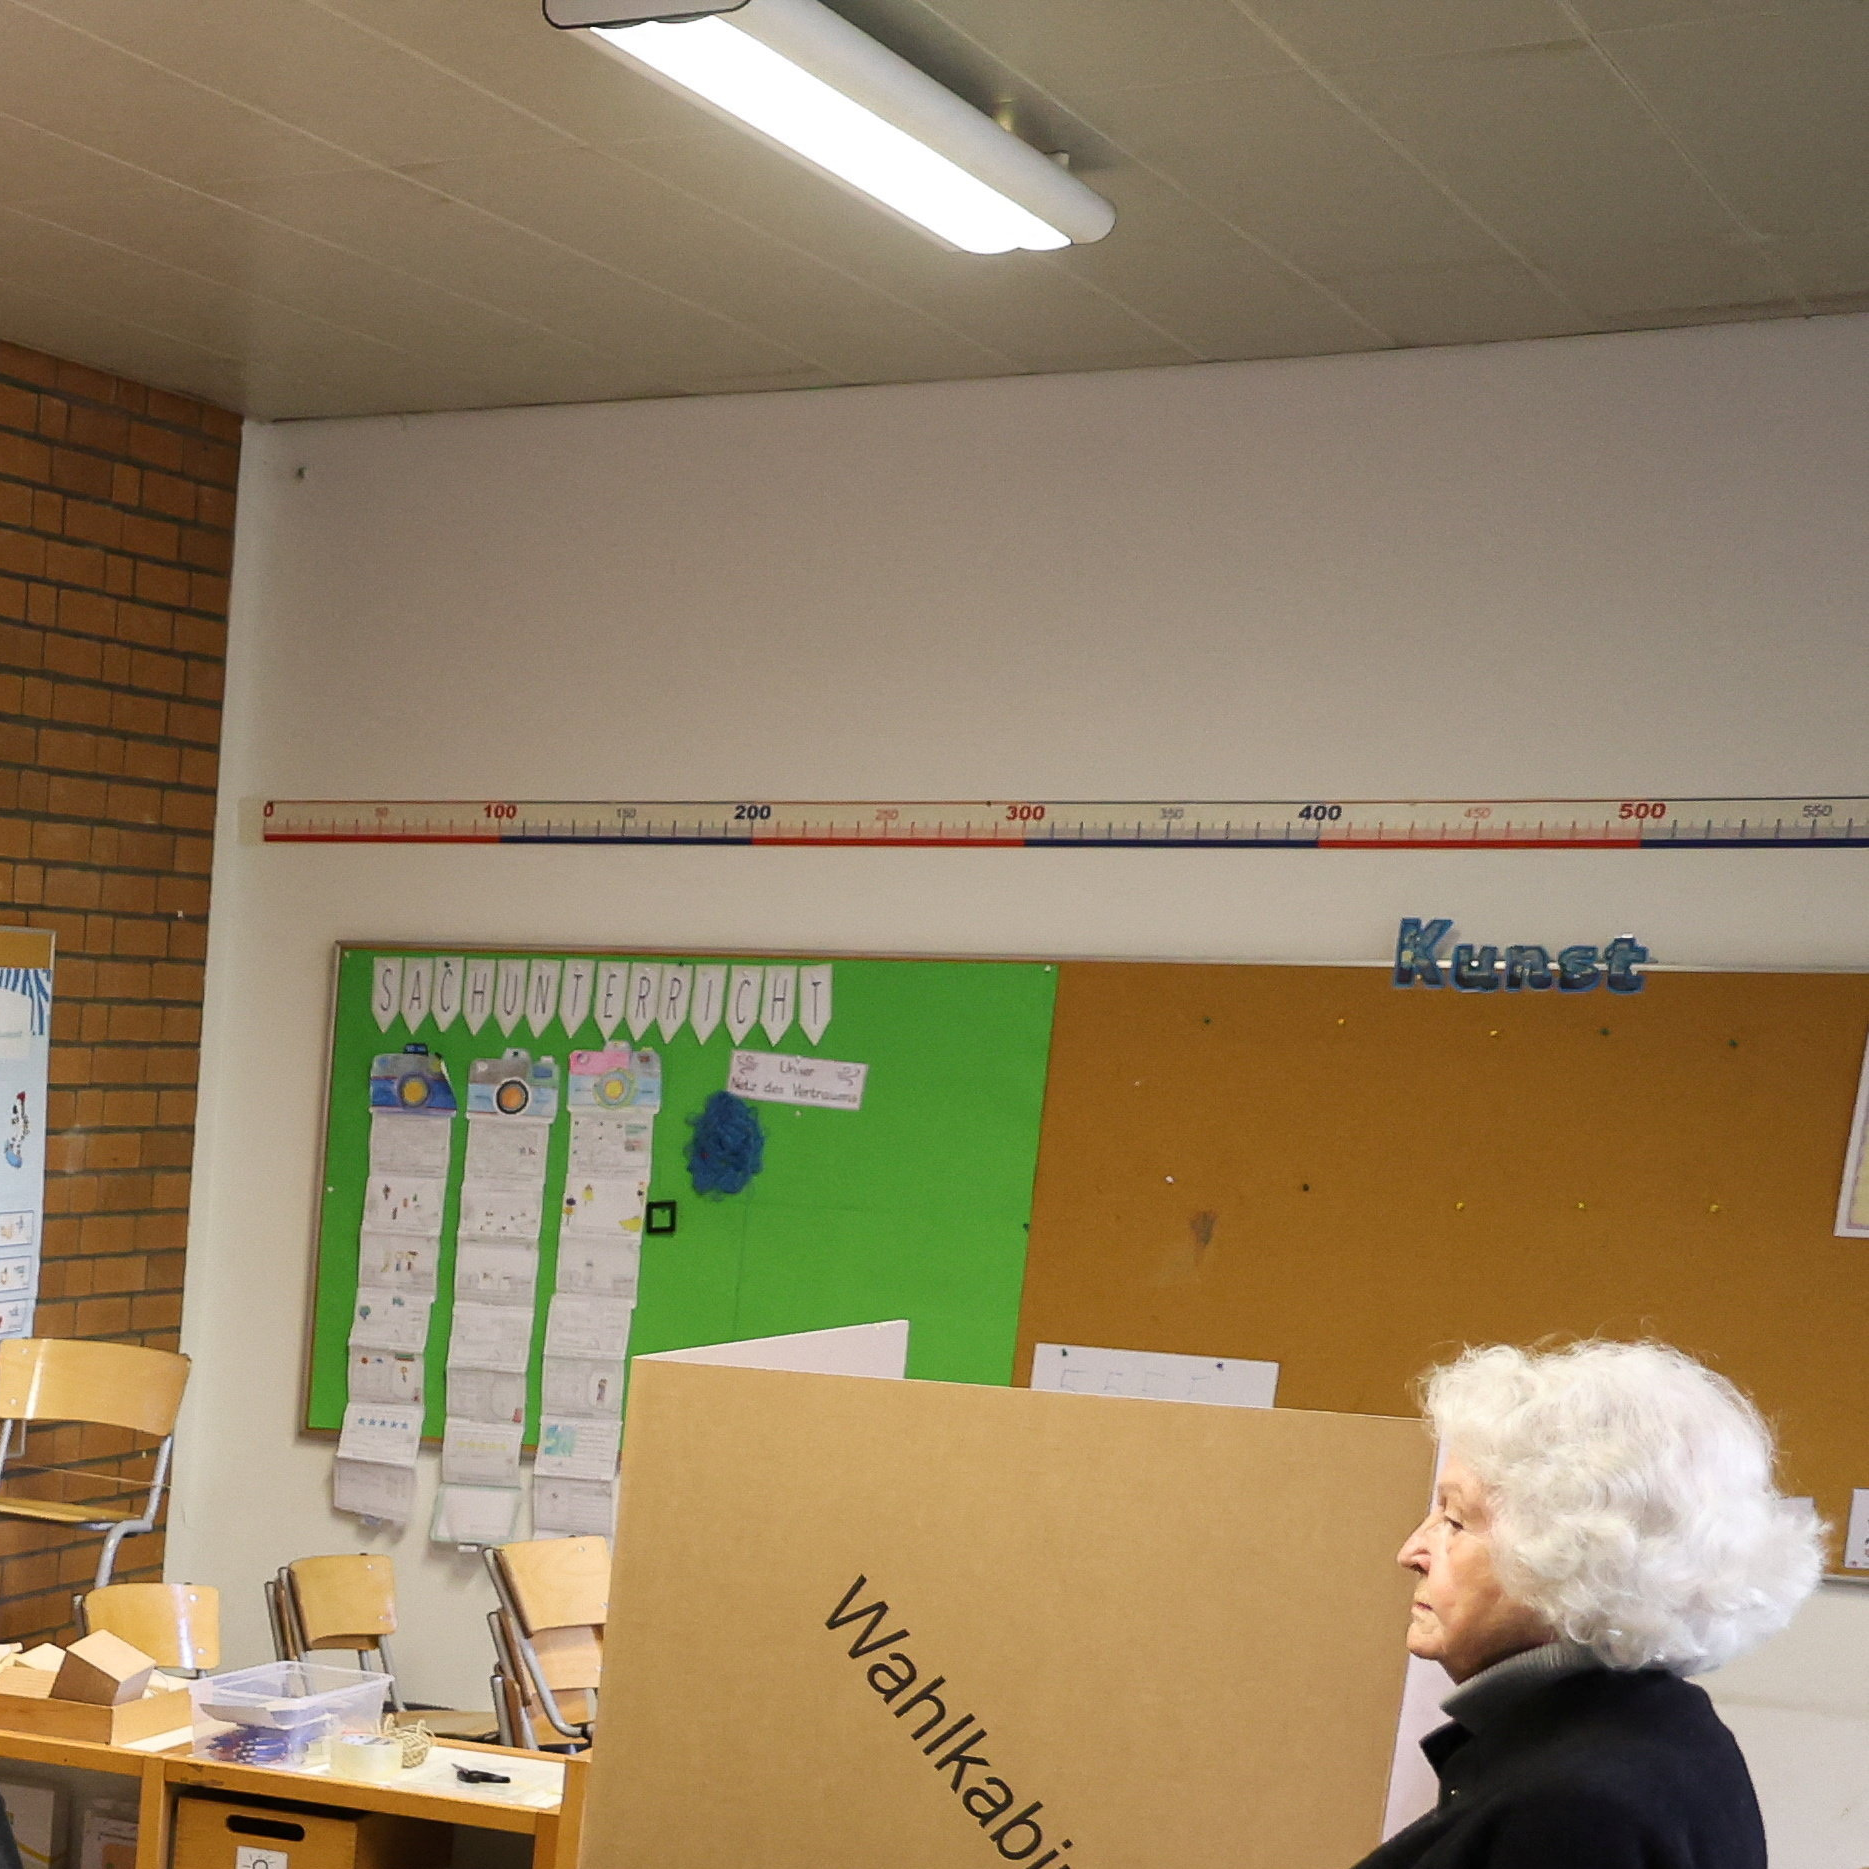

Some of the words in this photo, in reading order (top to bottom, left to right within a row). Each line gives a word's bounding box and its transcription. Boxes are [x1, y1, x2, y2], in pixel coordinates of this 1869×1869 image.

[483, 804, 517, 820] 100
[734, 805, 771, 820] 200
[1006, 805, 1045, 821] 300
[1298, 805, 1342, 821] 400
[1618, 803, 1666, 819] 500
[1803, 804, 1833, 818] 550
[1391, 918, 1650, 993] Kunst
[379, 967, 823, 1025] SACHUNTERRICHT
